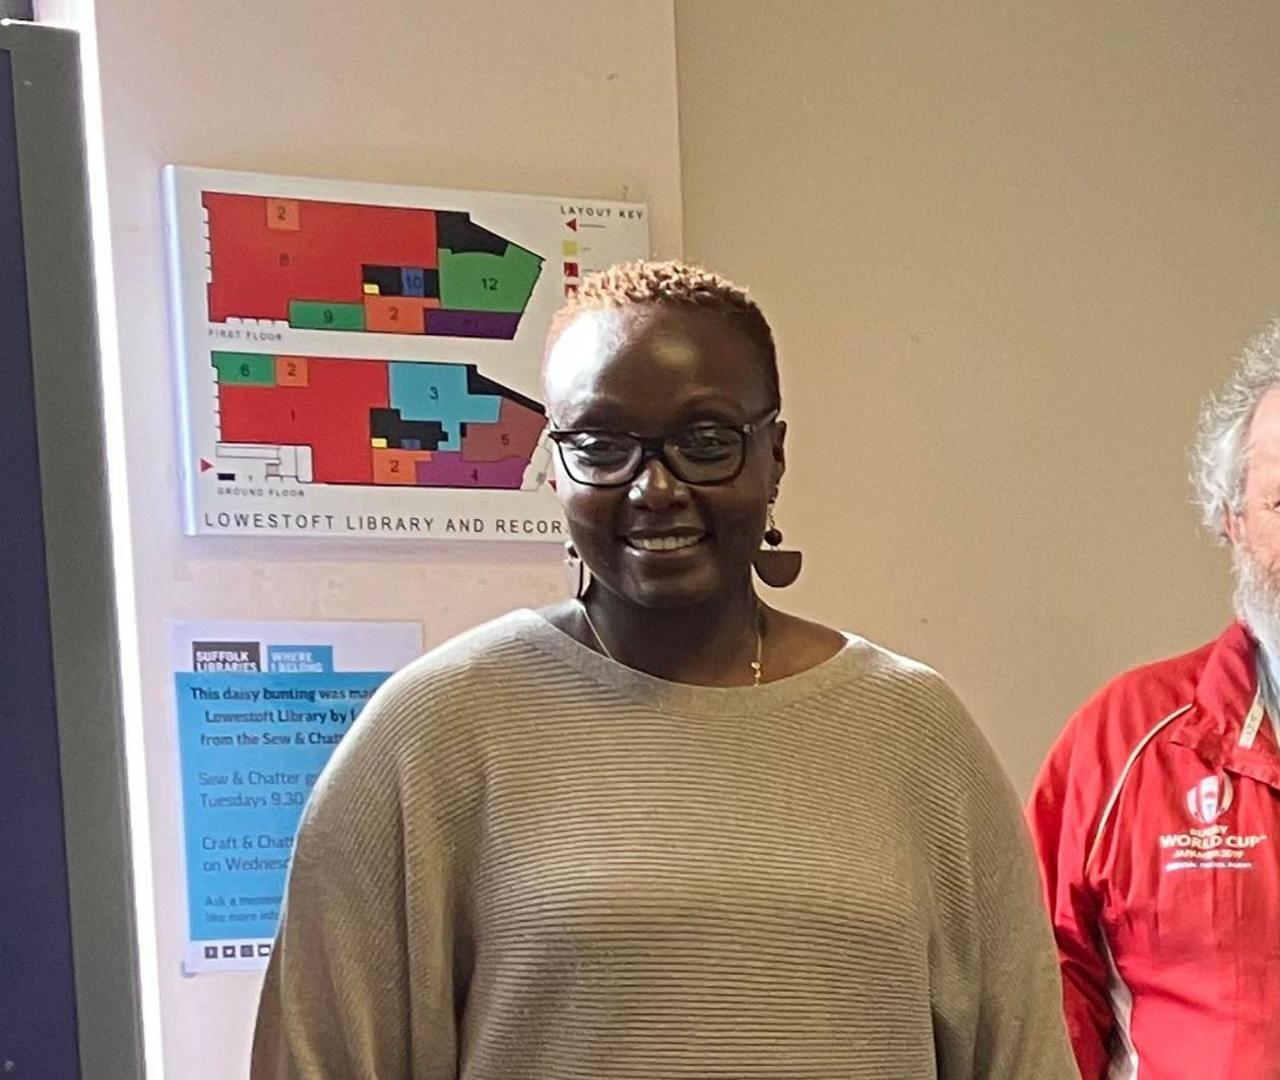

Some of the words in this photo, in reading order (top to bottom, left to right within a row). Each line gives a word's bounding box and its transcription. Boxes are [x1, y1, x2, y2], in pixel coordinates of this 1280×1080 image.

[277, 206, 286, 221] 2
[561, 206, 611, 217] LAYOUT
[619, 211, 643, 219] KEY
[404, 276, 422, 290] 10
[481, 277, 498, 291] 12
[323, 310, 333, 323] 9
[389, 307, 399, 321] 2
[246, 331, 282, 341] FLOOR
[287, 362, 297, 377] 2
[429, 386, 439, 400] 3
[390, 460, 399, 473] 2
[217, 487, 263, 496] GROUND
[269, 488, 305, 497] FLOOR
[205, 513, 335, 529] LOWESTOFT
[347, 516, 434, 531] LIBRARY
[446, 519, 484, 533] AND
[496, 519, 568, 534] RECOR
[196, 651, 249, 662] SUFFOLK
[190, 686, 220, 700] This
[223, 686, 259, 702] daisy
[263, 687, 316, 703] bunting
[317, 690, 346, 699] was
[205, 709, 275, 723] Lowestoft
[277, 709, 327, 725] Library
[330, 709, 347, 724] by
[201, 734, 233, 746] from
[237, 733, 259, 746] the
[263, 733, 291, 745] Sew
[198, 772, 230, 786] Sew
[247, 771, 300, 785] Chatter
[200, 792, 267, 808] Tuesdays
[202, 836, 238, 850] Craft
[1159, 834, 1222, 849] WORLD
[203, 861, 221, 872] on
